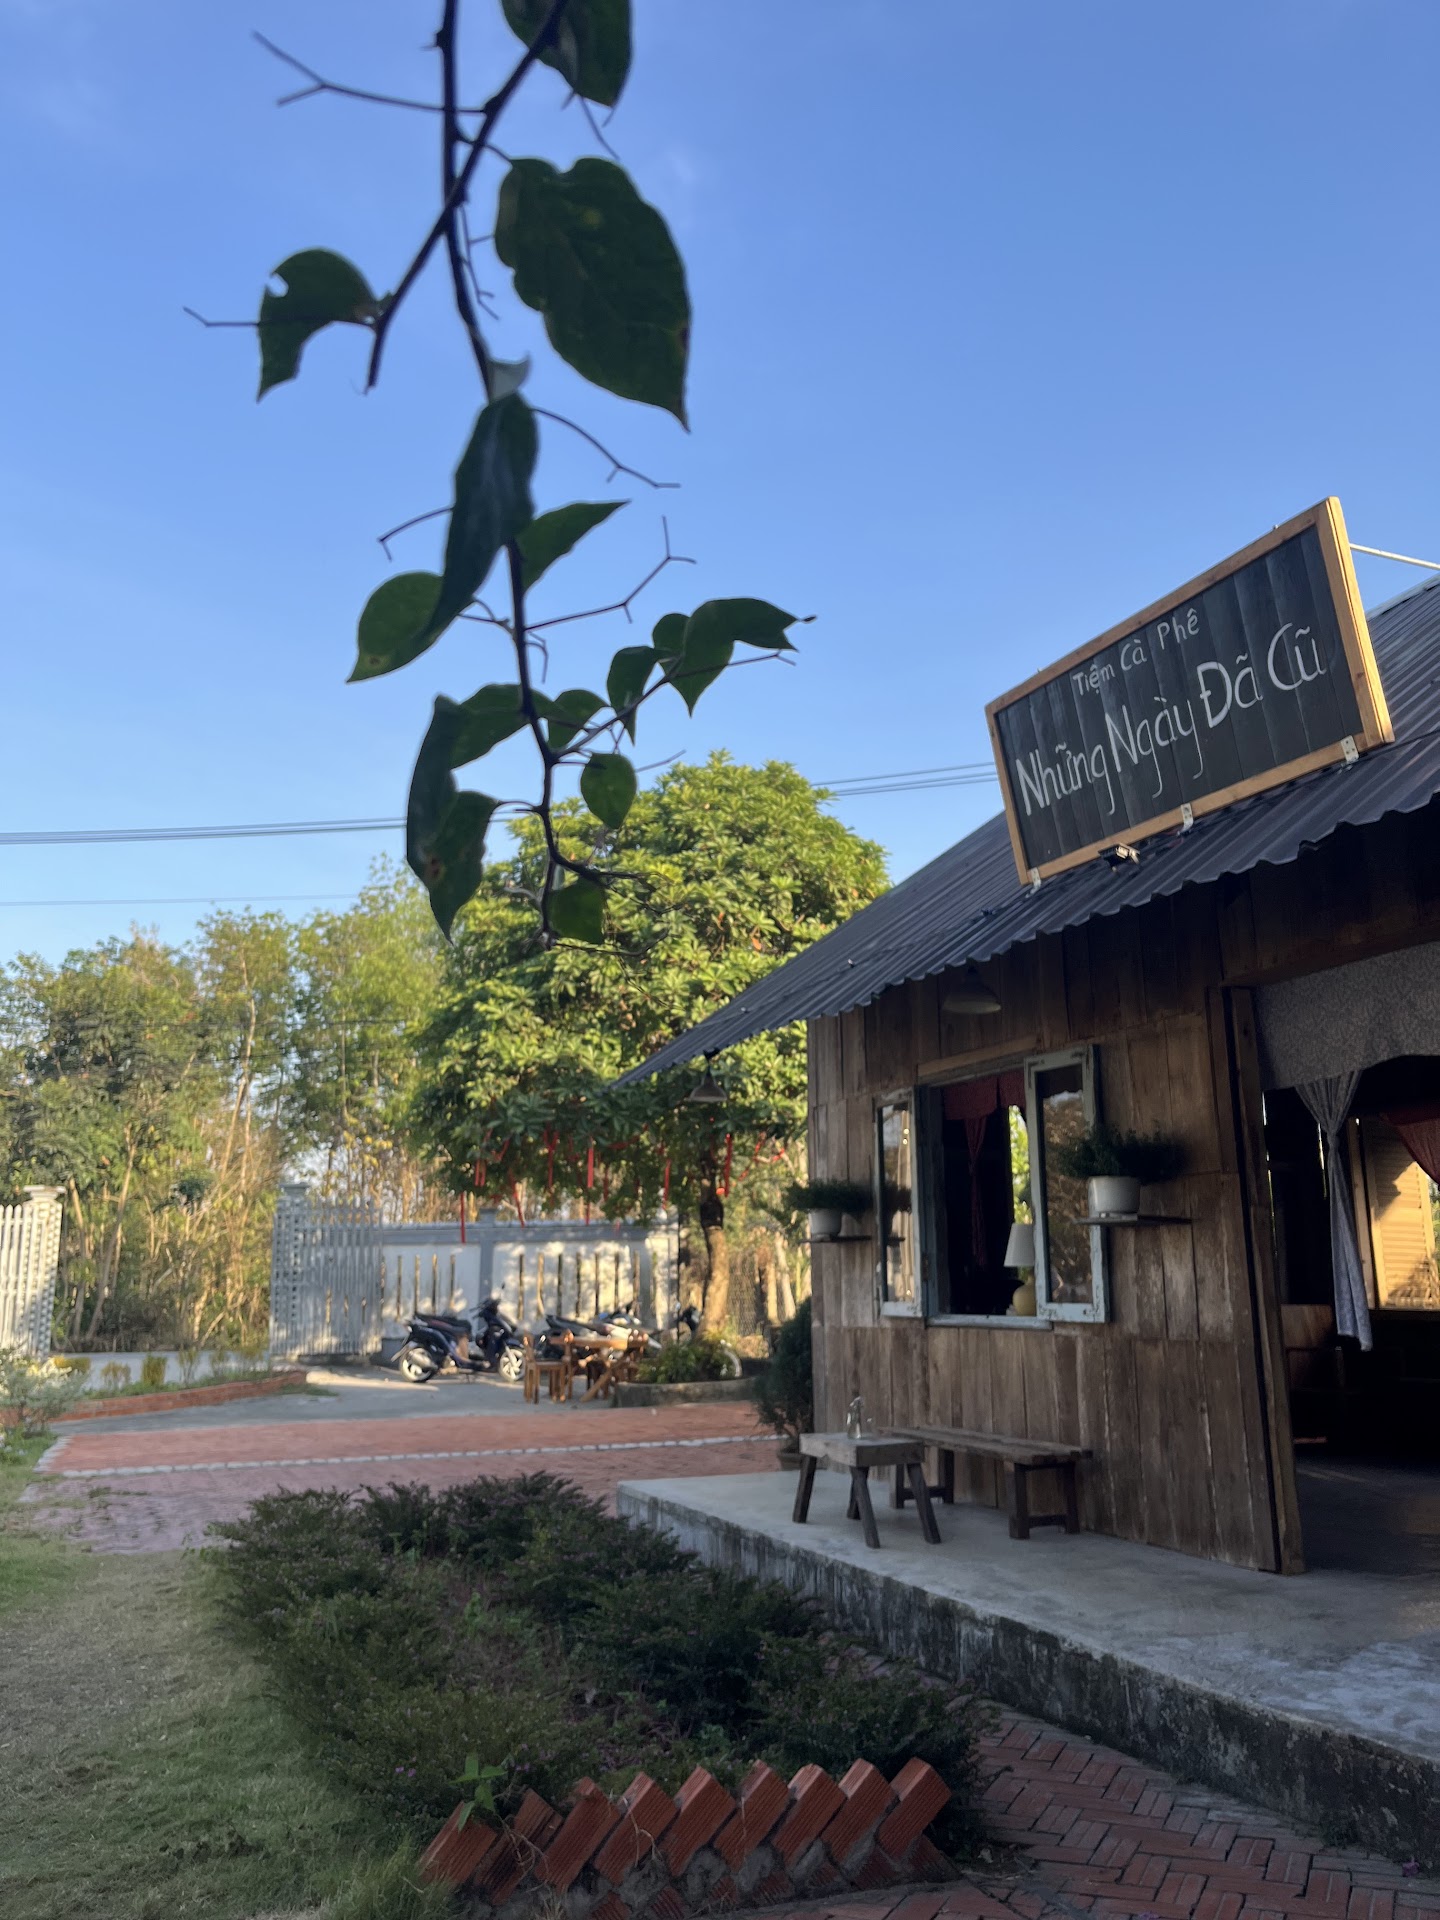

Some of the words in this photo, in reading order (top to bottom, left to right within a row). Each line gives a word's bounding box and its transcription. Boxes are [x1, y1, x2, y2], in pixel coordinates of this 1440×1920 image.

[1015, 741, 1116, 816] Những
[1104, 696, 1204, 799] Ngày
[1197, 653, 1264, 728] Đã
[1267, 622, 1326, 691] Cũ
[1072, 664, 1116, 696] Tiệm
[1120, 639, 1147, 672] Cà
[1156, 607, 1200, 650] Phê
